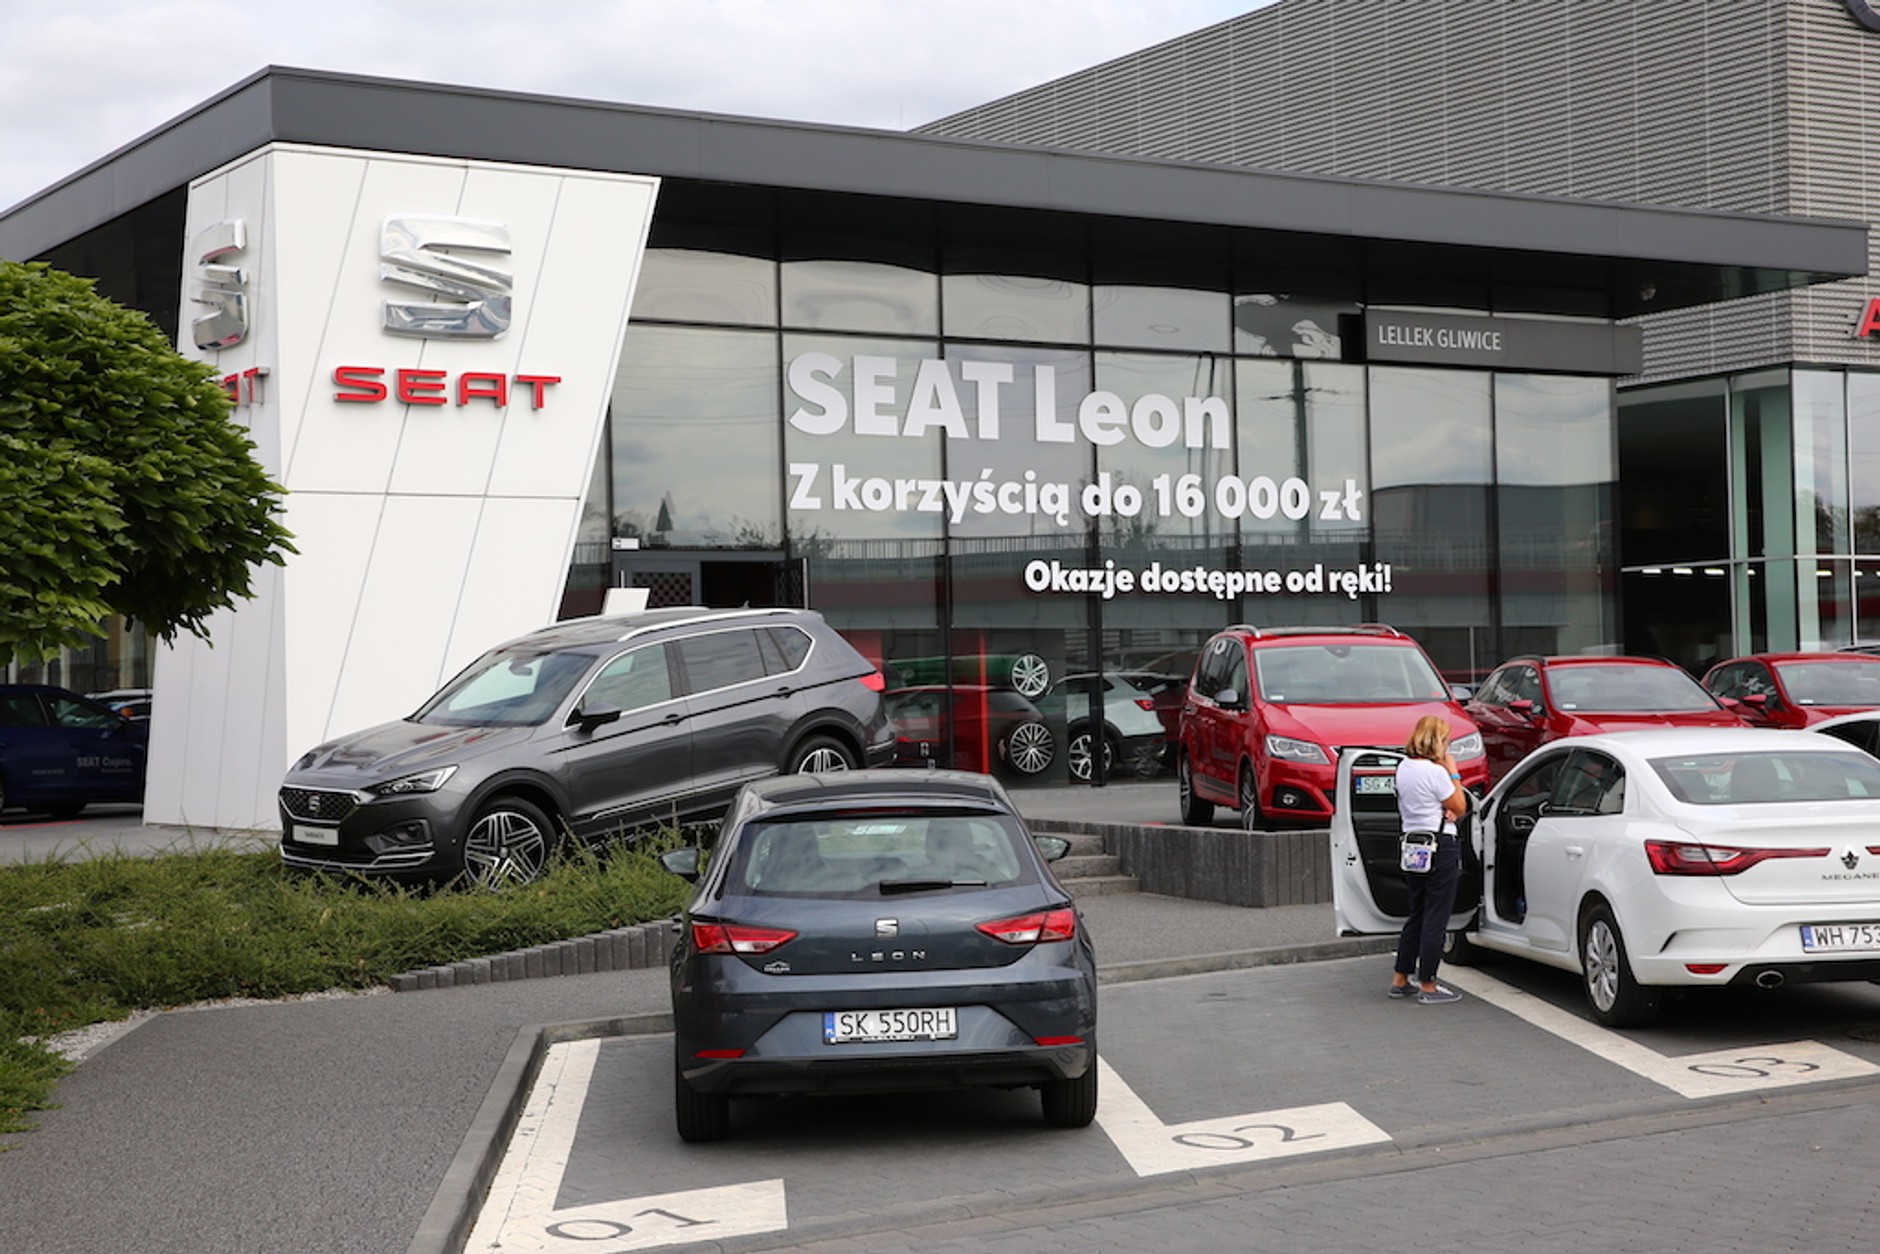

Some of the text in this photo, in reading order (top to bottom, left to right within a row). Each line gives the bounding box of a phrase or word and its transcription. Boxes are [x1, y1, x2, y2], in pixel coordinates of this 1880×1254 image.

[1378, 325, 1502, 351] LELLEK GLIWICE
[333, 366, 562, 411] SEAT
[788, 352, 1231, 450] SEAT Leon
[789, 462, 1363, 527] Z korzyścią do 16 000 zł
[1024, 559, 1393, 600] Okazje dostępne od ręki!
[1363, 777, 1380, 791] SG
[1814, 926, 1845, 945] WH
[851, 951, 926, 962] LEON
[840, 1010, 951, 1036] SK 550RH
[1687, 1057, 1820, 1079] 03
[1171, 1124, 1326, 1150] 02
[545, 1208, 720, 1241] 01
